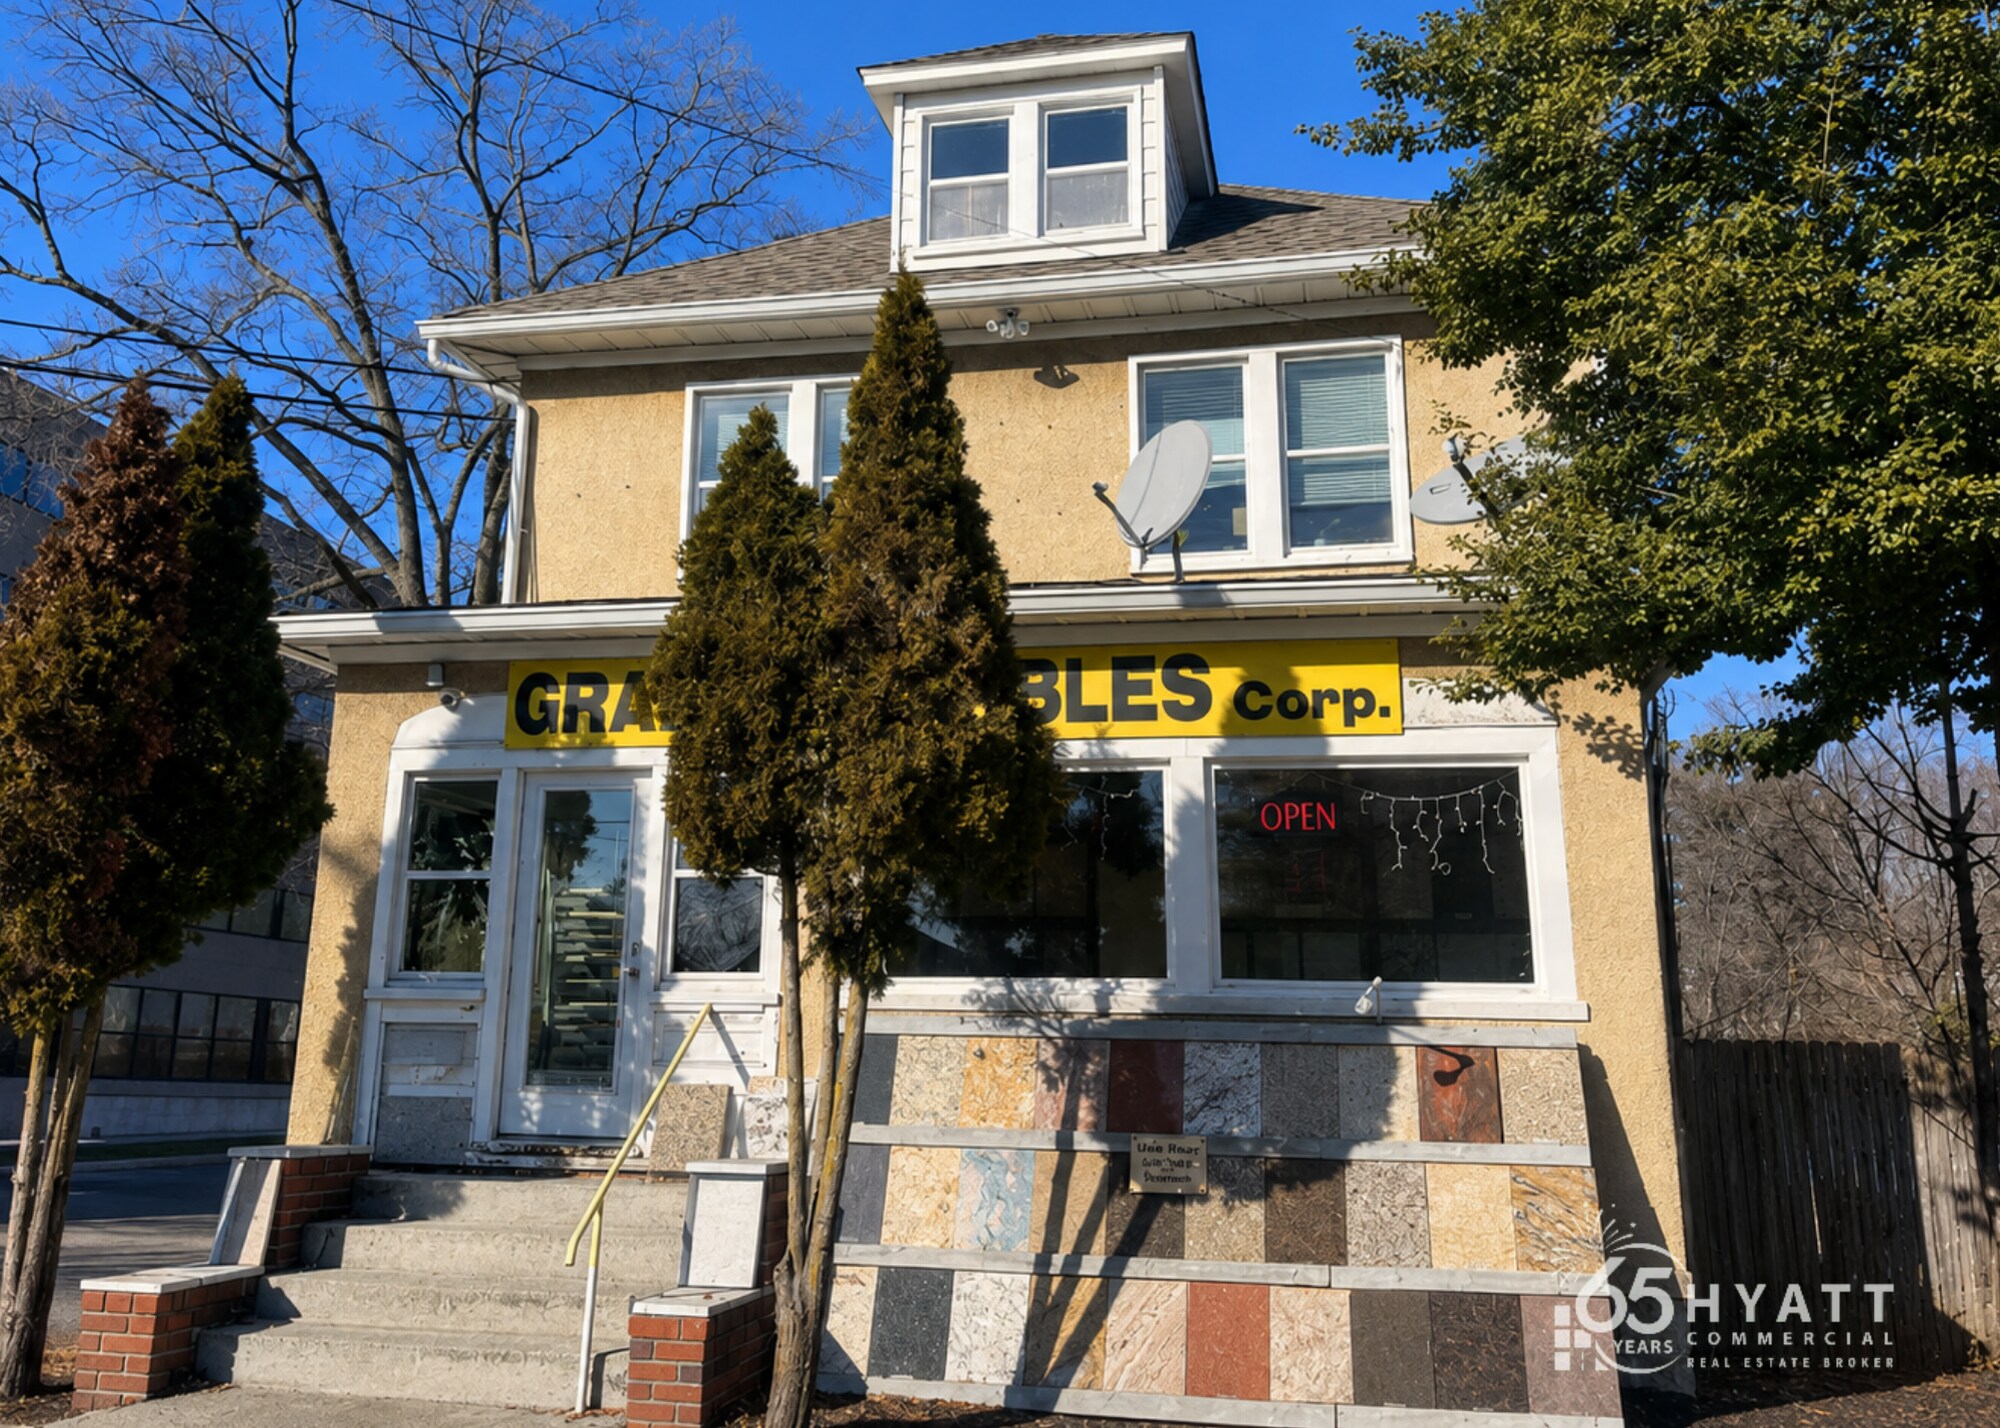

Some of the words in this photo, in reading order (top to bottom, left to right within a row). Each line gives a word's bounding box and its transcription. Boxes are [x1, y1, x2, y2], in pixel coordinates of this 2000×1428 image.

[515, 670, 676, 736] GRA
[1018, 653, 1213, 724] BLES
[1232, 680, 1391, 727] Corp.
[1260, 801, 1337, 831] OPEN
